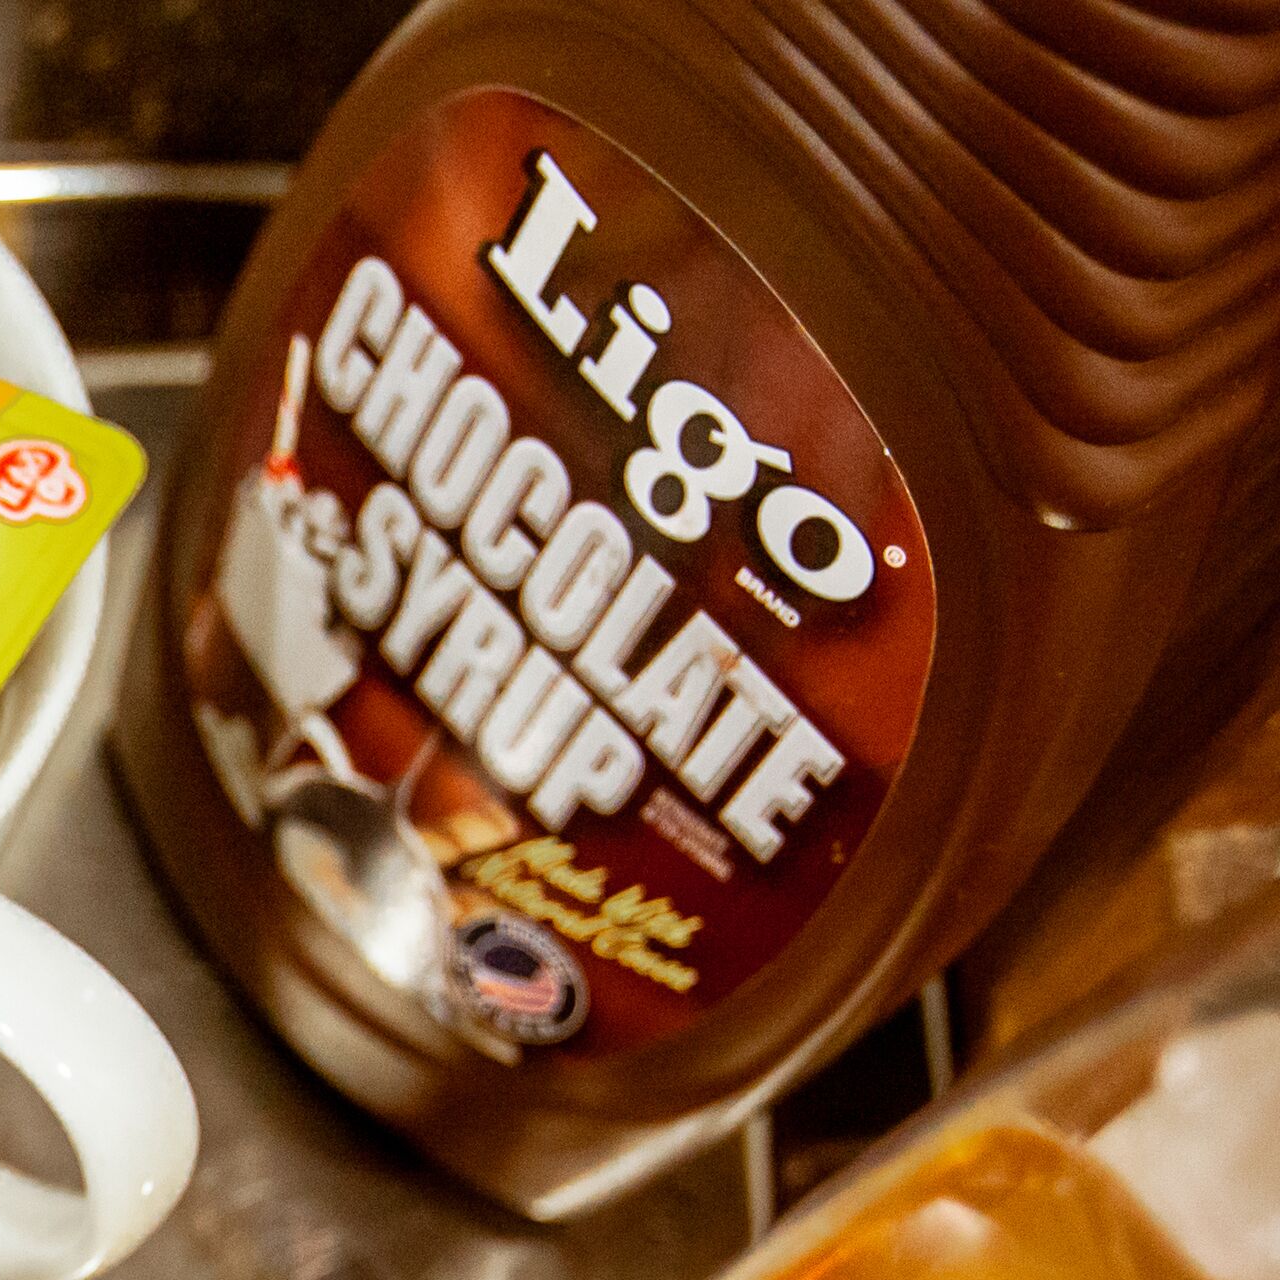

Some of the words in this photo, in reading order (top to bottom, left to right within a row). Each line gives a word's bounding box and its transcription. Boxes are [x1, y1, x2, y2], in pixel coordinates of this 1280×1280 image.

[488, 151, 875, 602] Ligo
[313, 256, 847, 864] CHOCOLATE
[334, 482, 647, 832] SYRUP
[734, 565, 801, 629] BRAND
[510, 835, 608, 903] Made
